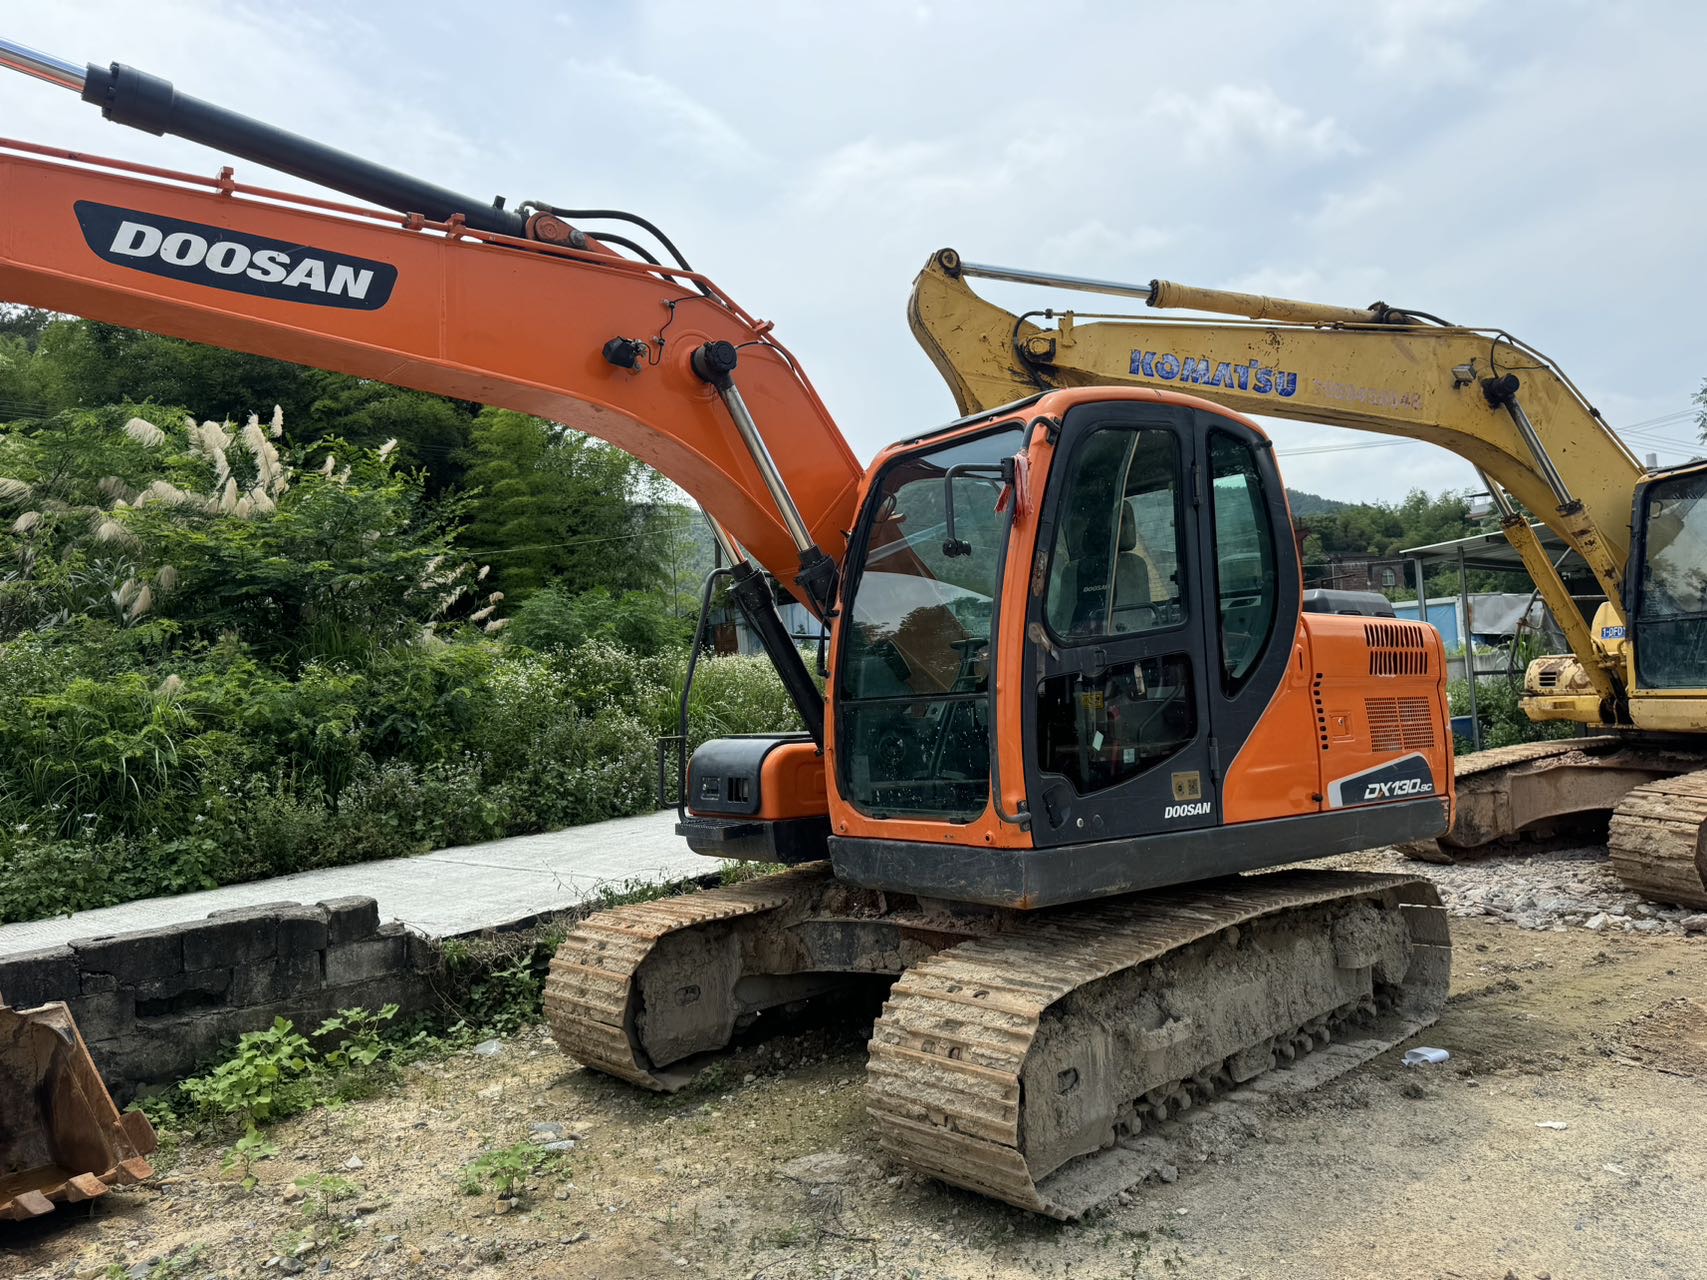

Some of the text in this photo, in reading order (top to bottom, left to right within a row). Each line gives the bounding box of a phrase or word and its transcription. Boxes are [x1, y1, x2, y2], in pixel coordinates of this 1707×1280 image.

[109, 220, 374, 300] DOOSAN
[1128, 348, 1298, 397] KOMATSU
[1164, 801, 1211, 819] DOOSAN
